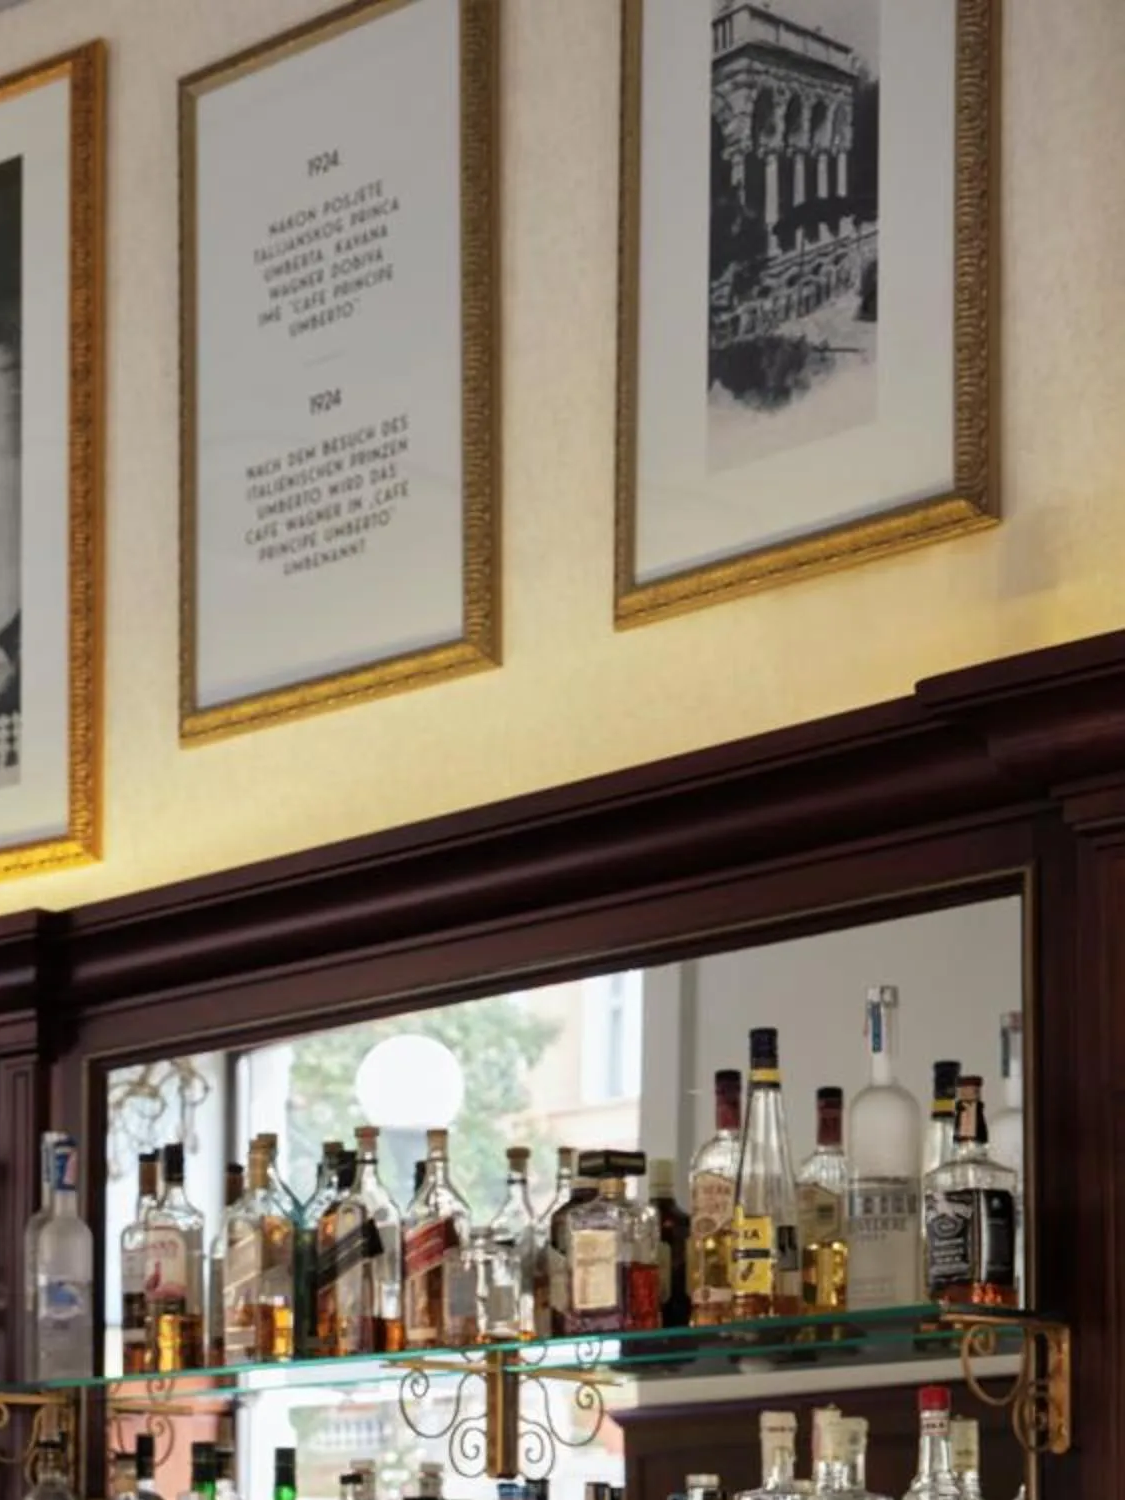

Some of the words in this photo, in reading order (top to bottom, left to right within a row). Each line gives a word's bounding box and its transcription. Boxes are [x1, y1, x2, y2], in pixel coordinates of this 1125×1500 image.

[307, 149, 339, 177] 1924
[257, 305, 282, 327] IME
[333, 263, 394, 299] PRINCIPE
[268, 269, 324, 299] WAGNER
[308, 388, 342, 415] 1924
[245, 458, 281, 479] NACH
[287, 446, 316, 466] DEM
[321, 427, 375, 455] BESUCH
[380, 414, 408, 436] DES
[256, 488, 321, 520] UMBERTO
[328, 475, 363, 496] WIRD
[369, 464, 396, 485] DAS
[285, 503, 342, 531] WAGNER
[347, 497, 362, 513] IN
[258, 531, 317, 561] PRINCIPE
